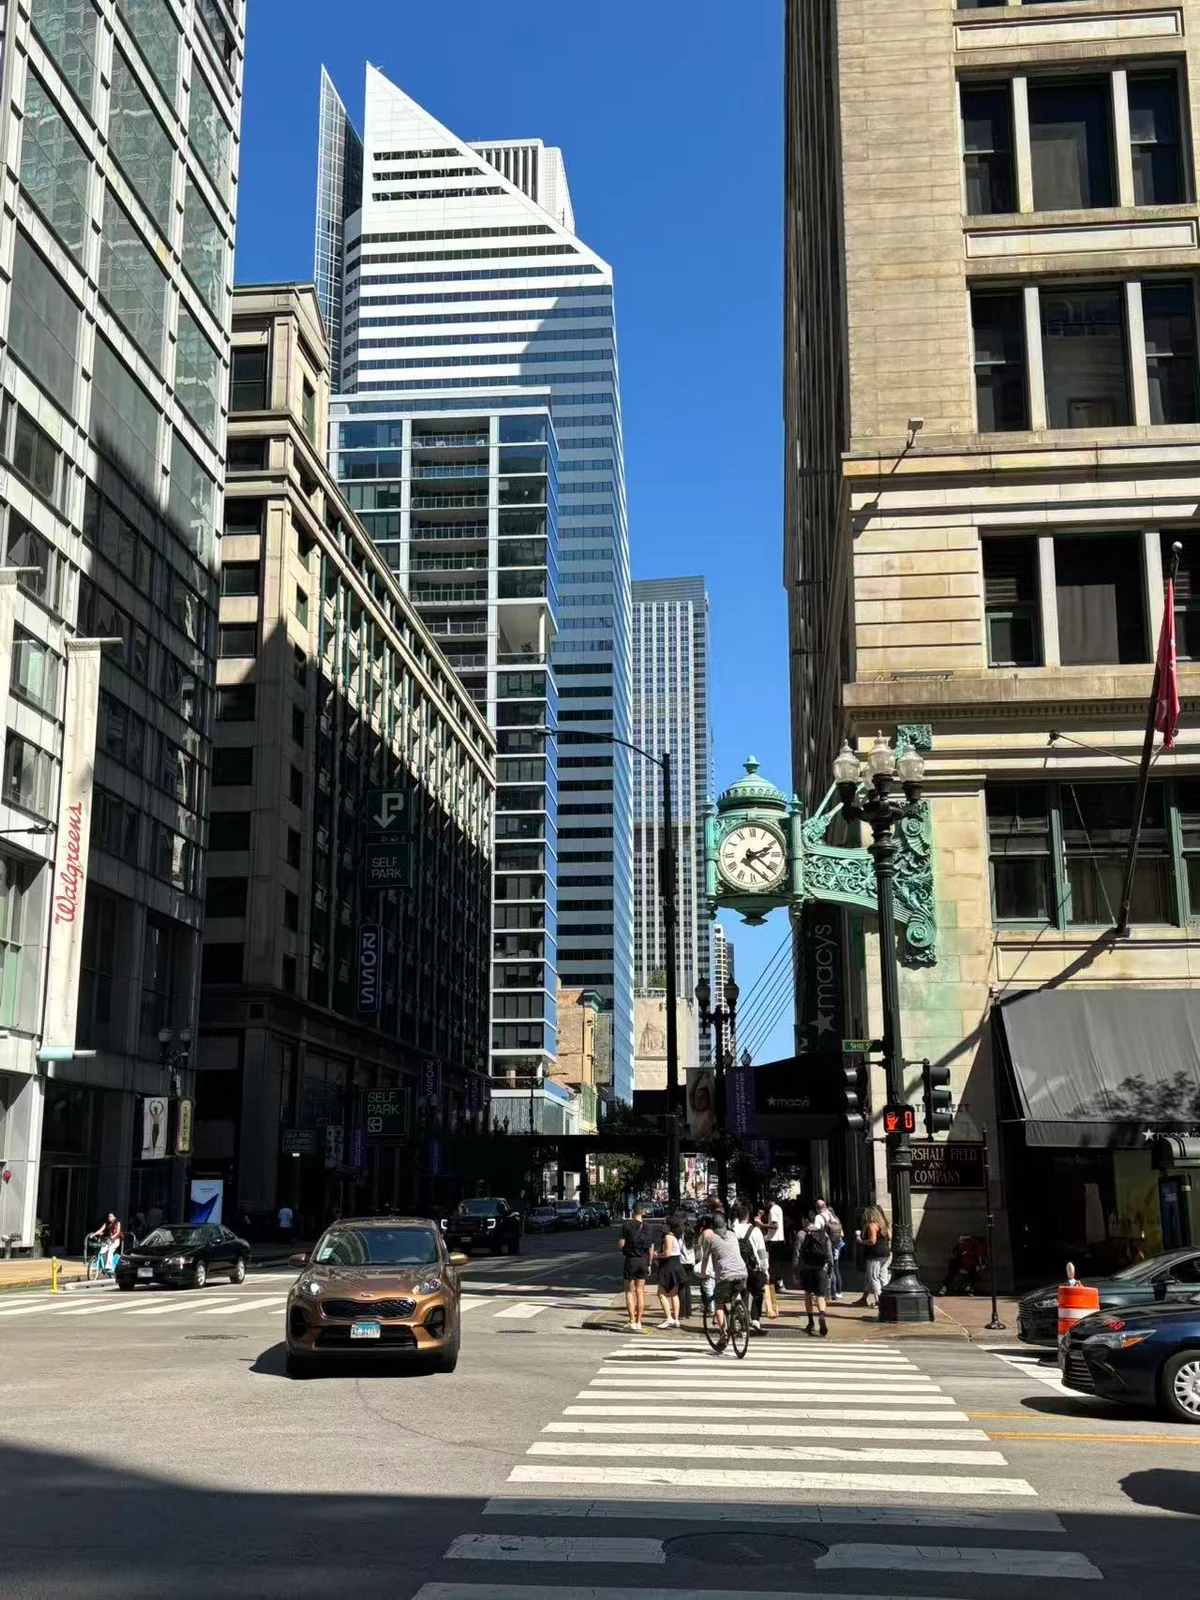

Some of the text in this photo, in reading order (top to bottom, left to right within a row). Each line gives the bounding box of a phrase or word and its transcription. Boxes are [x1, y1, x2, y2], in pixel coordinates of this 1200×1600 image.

[55, 801, 84, 924] Walgreens
[372, 856, 398, 868] SELF
[371, 868, 402, 878] PARK
[361, 932, 377, 1004] ROSS
[805, 924, 839, 1009] macy's
[425, 1061, 435, 1096] ROSS
[367, 1091, 396, 1103] SELF
[367, 1104, 400, 1115] PARK
[904, 1111, 913, 1128] 0
[911, 1147, 977, 1161] RSHALL FIELD
[914, 1170, 961, 1185] COMPANY
